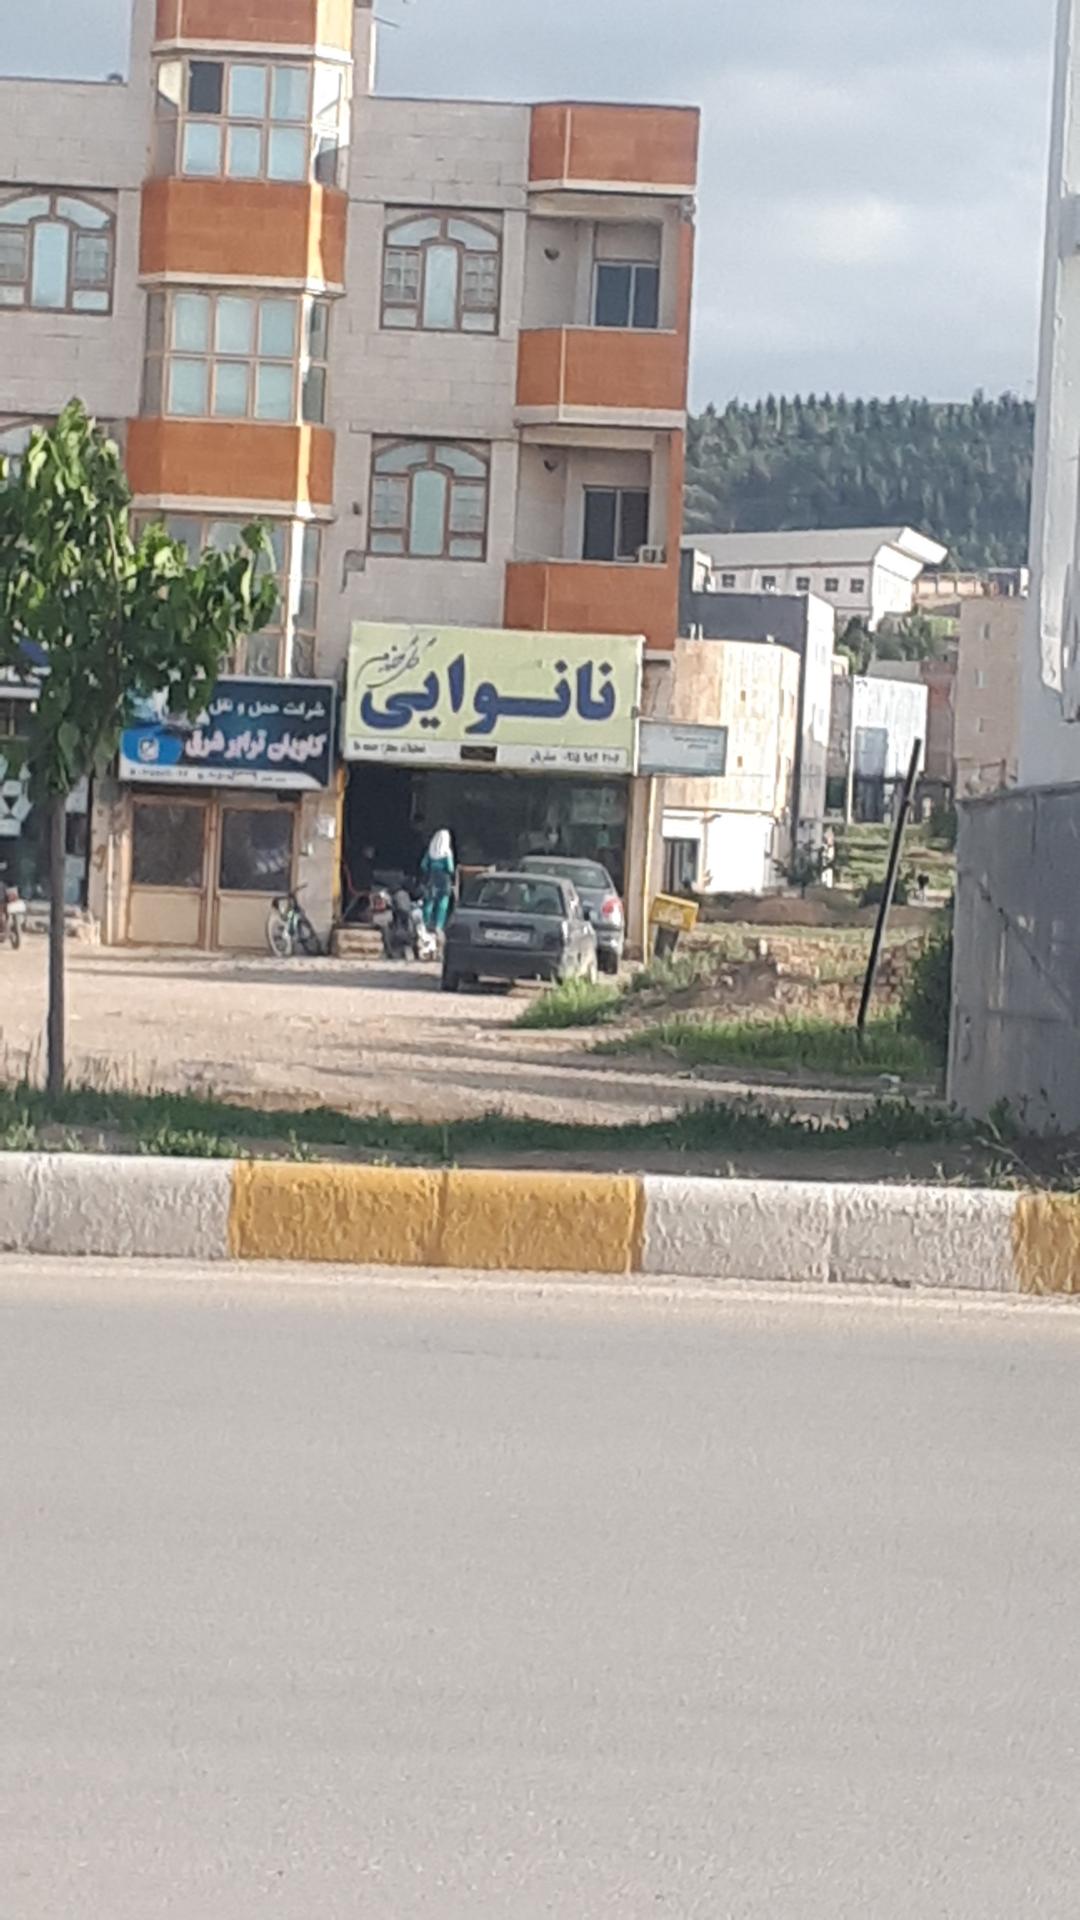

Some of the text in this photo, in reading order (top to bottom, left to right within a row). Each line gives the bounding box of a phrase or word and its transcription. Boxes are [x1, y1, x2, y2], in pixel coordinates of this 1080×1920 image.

[208, 697, 326, 721] شرکت حمل و نقل
[360, 653, 617, 735] نانوایی
